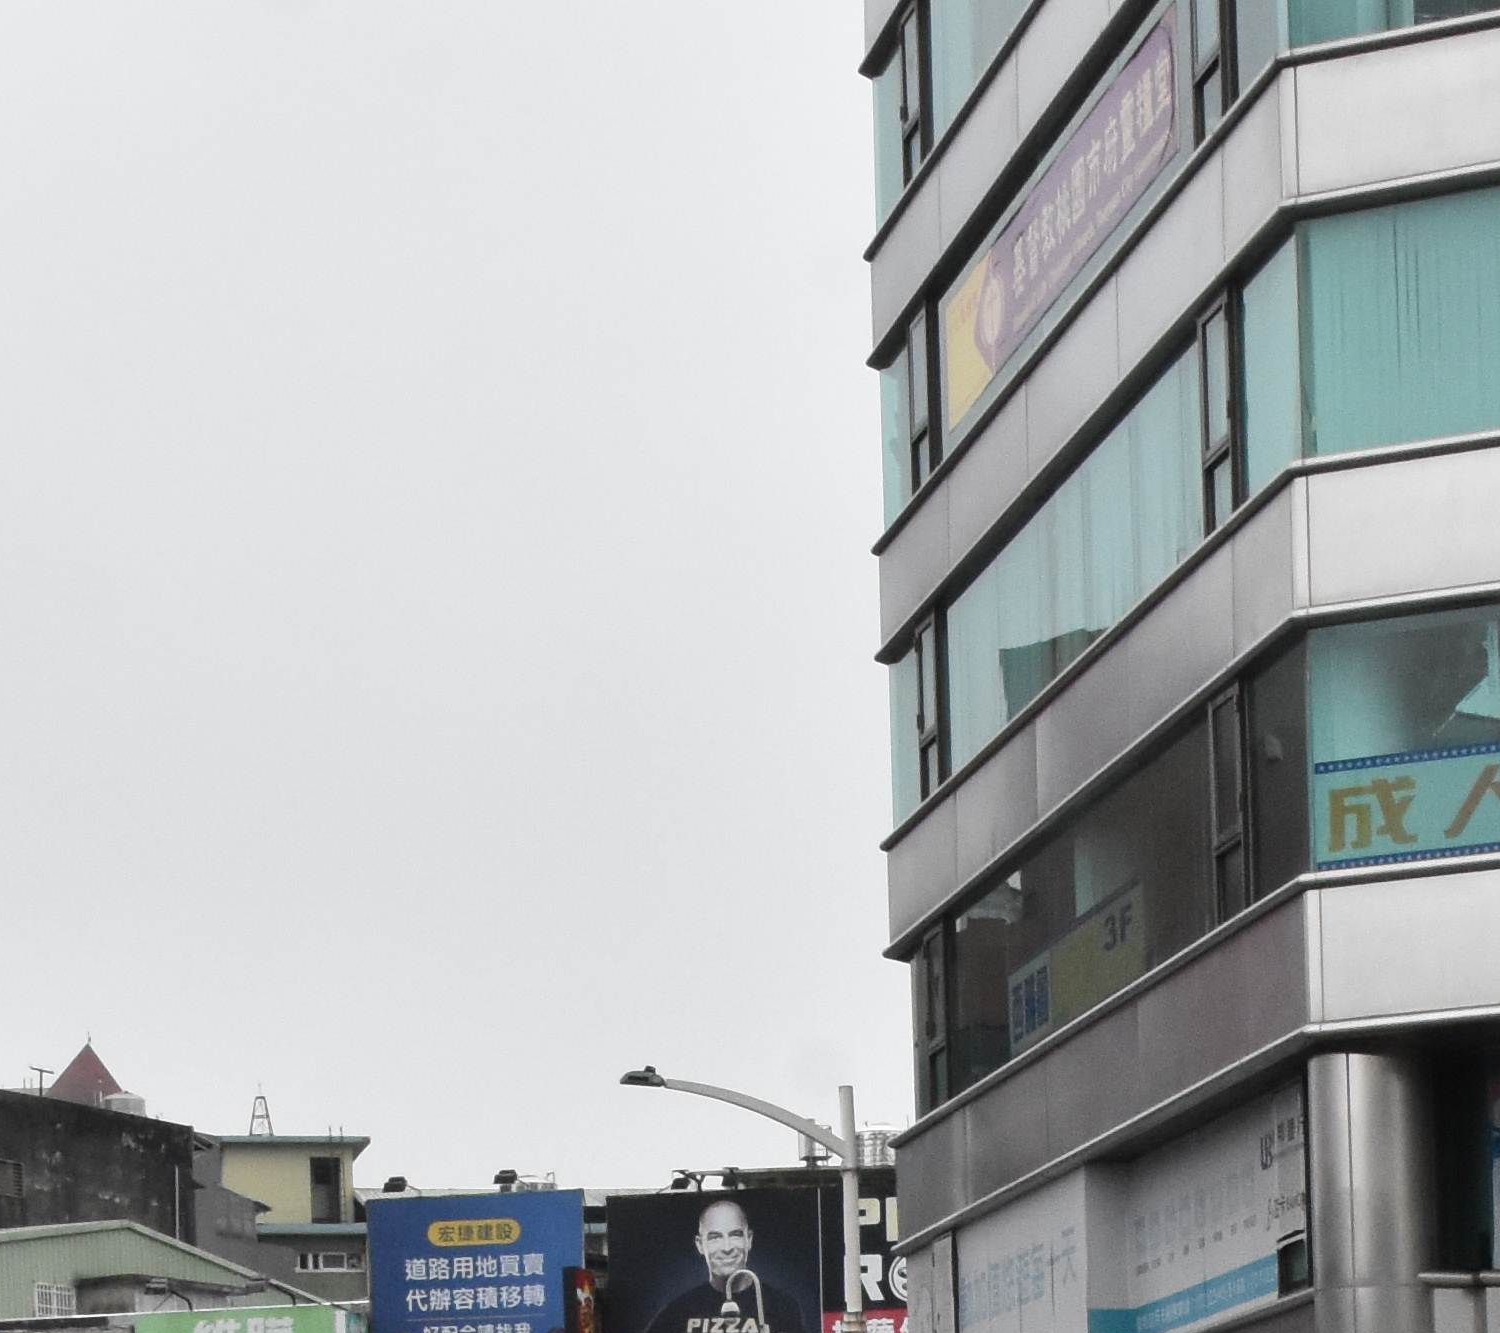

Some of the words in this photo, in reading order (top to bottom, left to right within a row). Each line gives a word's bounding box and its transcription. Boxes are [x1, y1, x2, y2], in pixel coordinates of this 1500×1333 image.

[404, 1252, 545, 1281] 道路用地買賣
[405, 1283, 546, 1312] 代辦容積移轉
[687, 1317, 759, 1333] PIZZA
